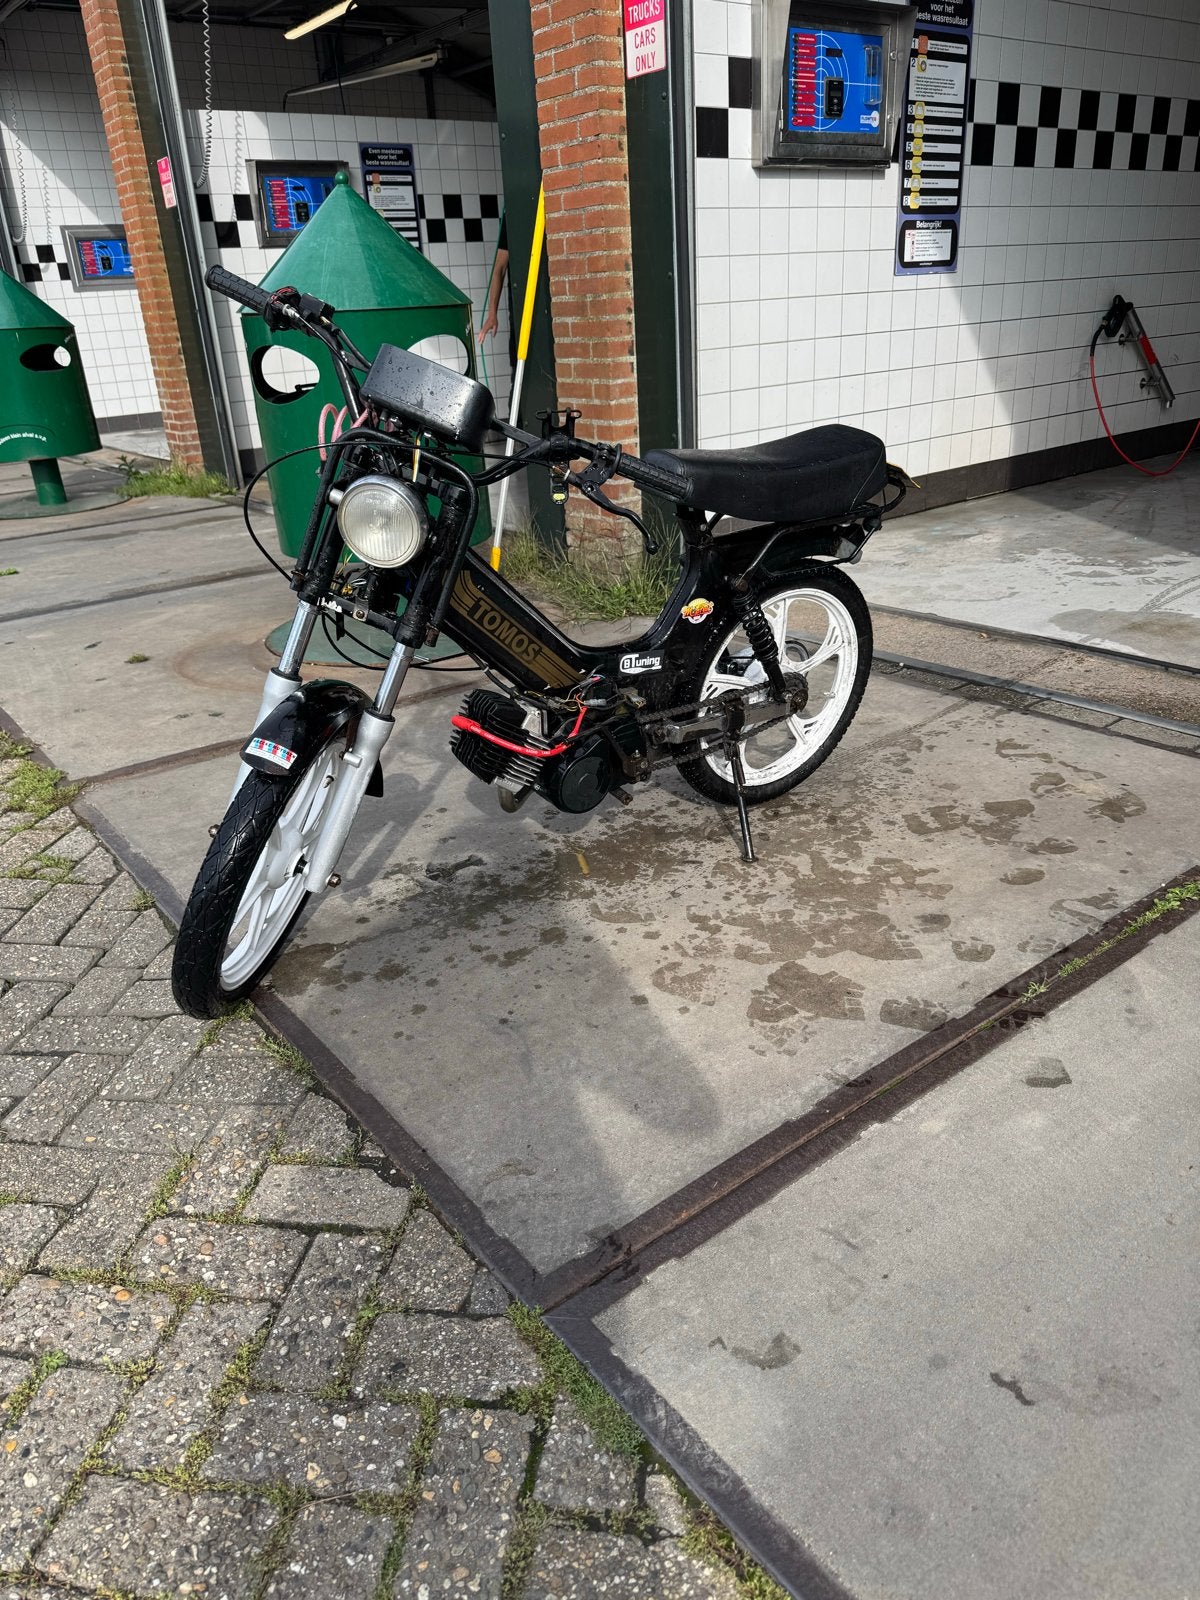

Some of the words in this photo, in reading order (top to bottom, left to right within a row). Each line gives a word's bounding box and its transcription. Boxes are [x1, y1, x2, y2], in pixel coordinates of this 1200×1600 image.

[628, 0, 660, 24] TRUCKS
[931, 3, 943, 12] voor
[945, 4, 954, 13] het
[635, 27, 656, 49] CARS
[635, 51, 656, 72] ONLY
[911, 58, 916, 67] 2
[909, 105, 914, 115] 3
[907, 142, 912, 152] 5
[906, 160, 911, 170] 6
[905, 178, 910, 188] 7
[472, 601, 541, 663] TOMOS
